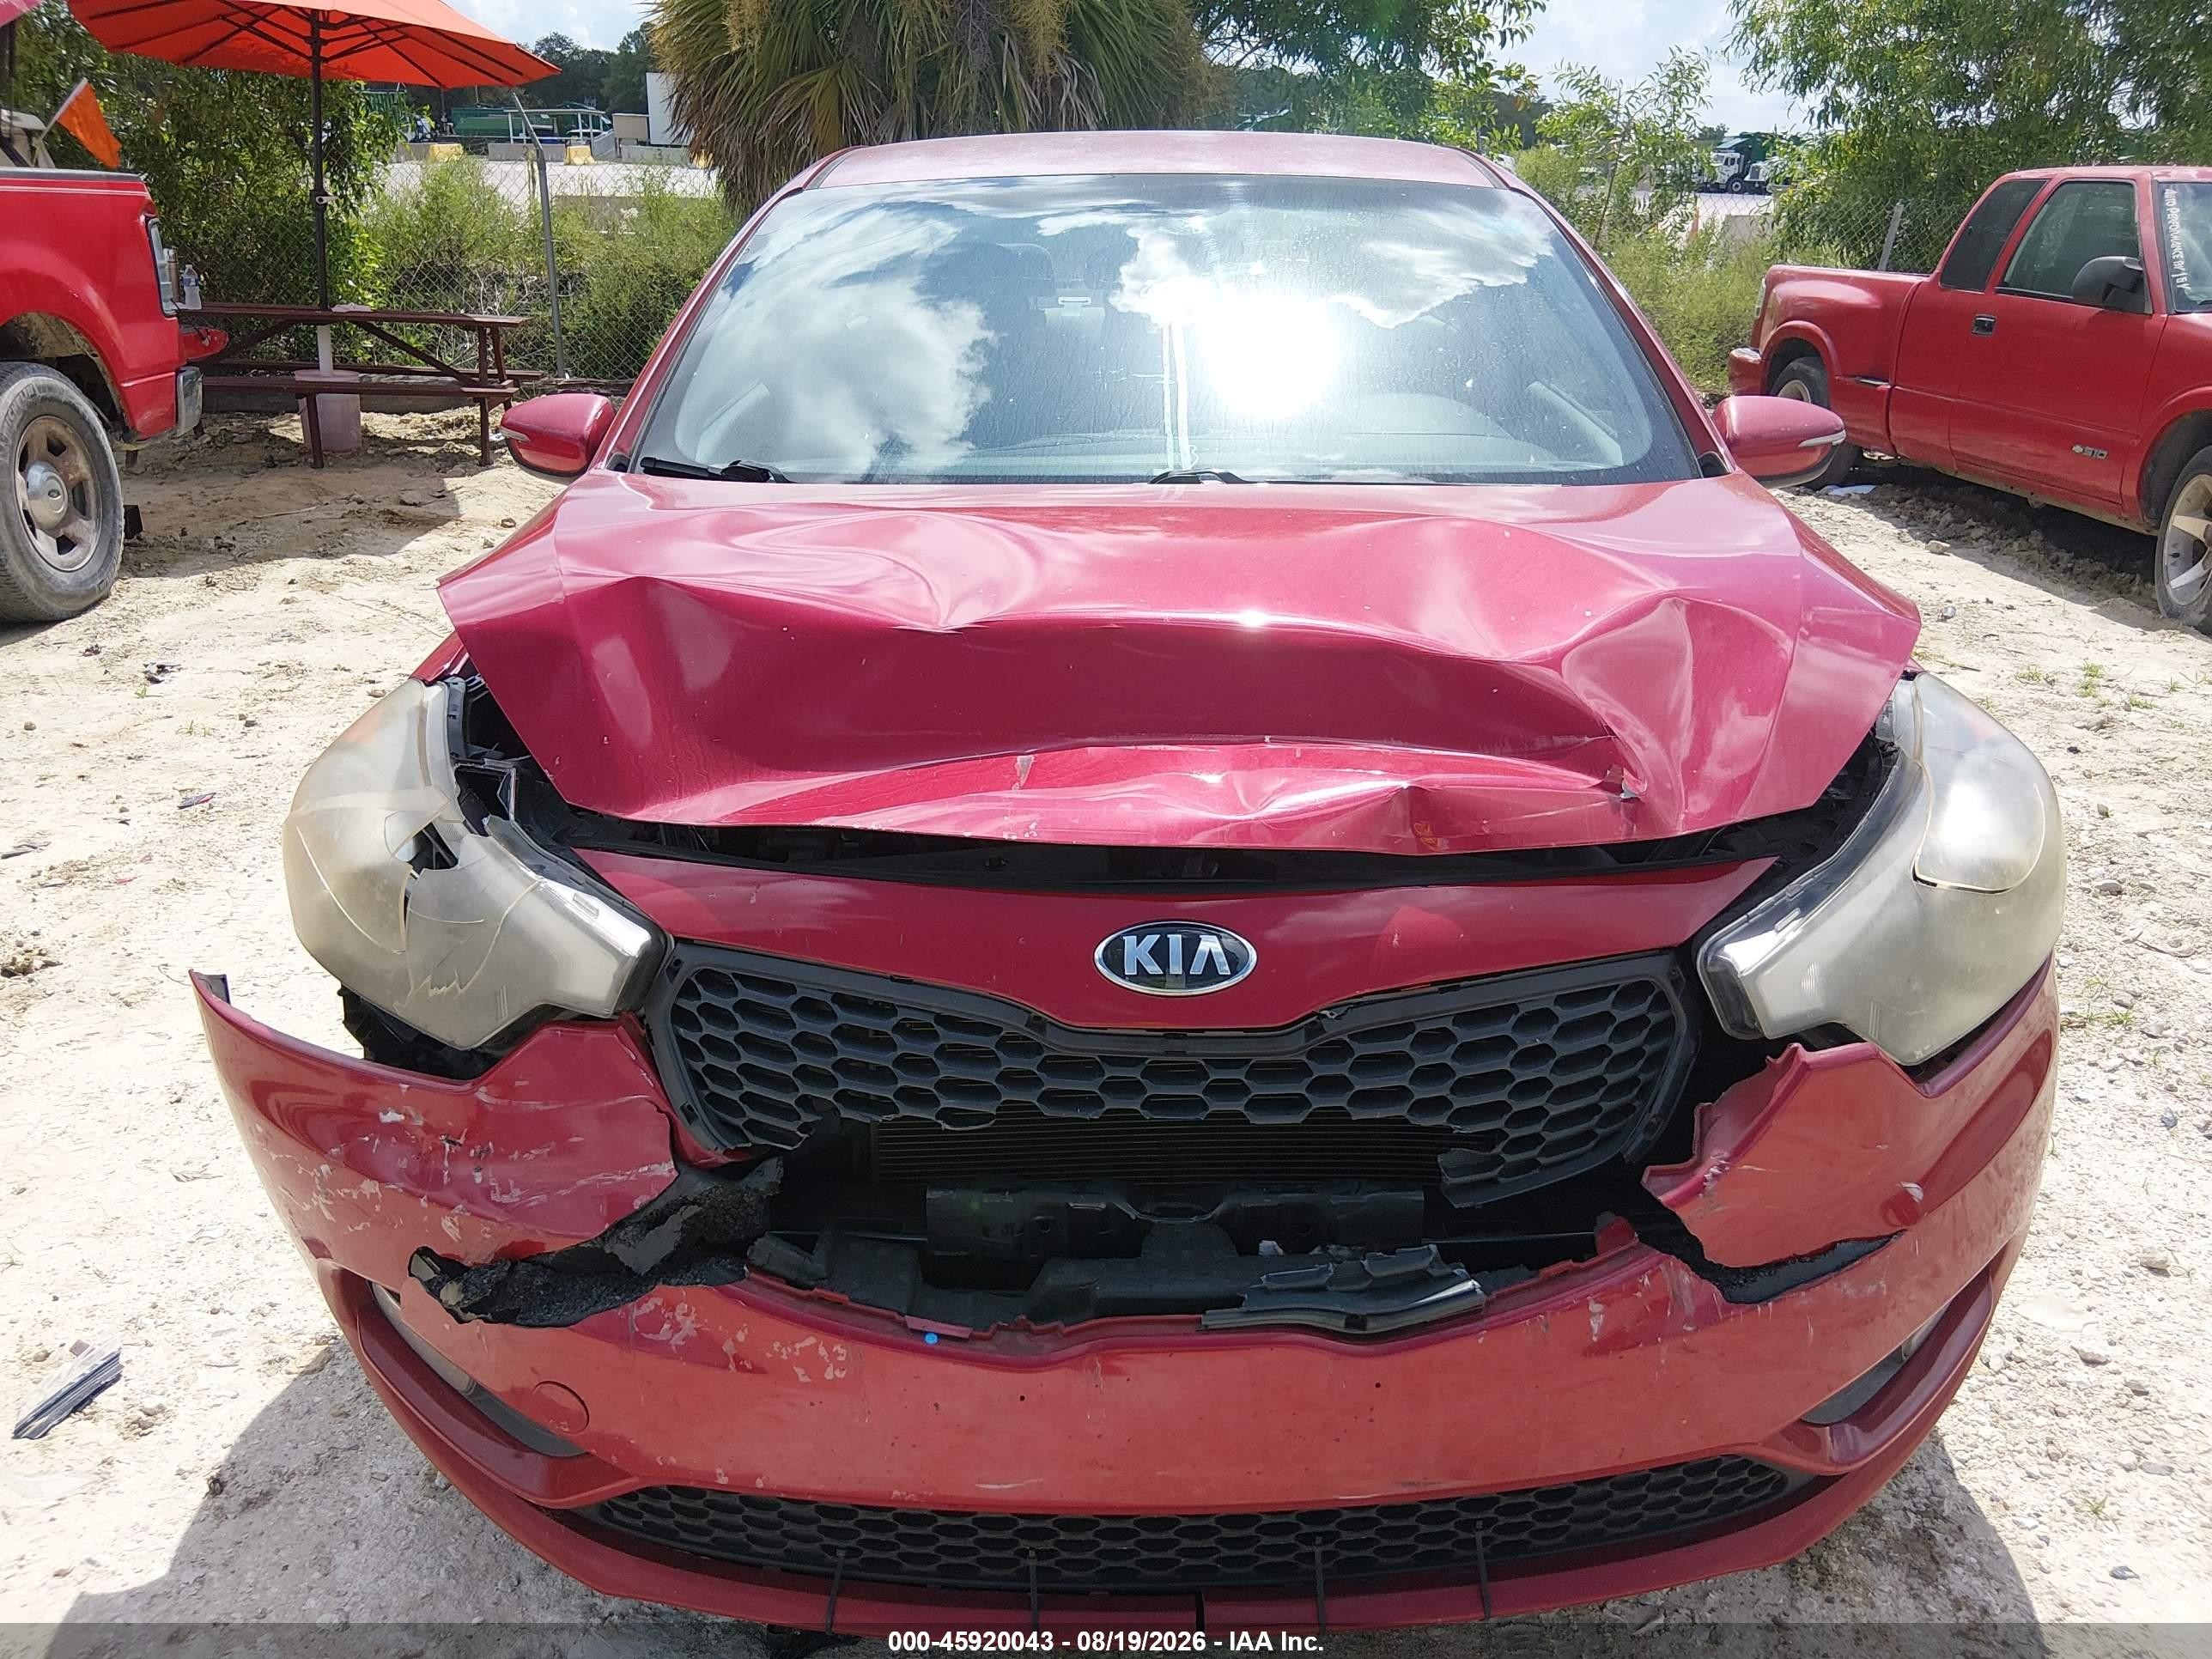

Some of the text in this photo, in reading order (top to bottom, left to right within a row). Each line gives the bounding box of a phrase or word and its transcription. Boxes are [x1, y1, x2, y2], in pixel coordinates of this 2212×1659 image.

[2164, 188, 2177, 207] AUTO
[2166, 207, 2184, 260] PERFORMANCE
[2173, 260, 2185, 271] BY
[1122, 934, 1231, 975] KIA
